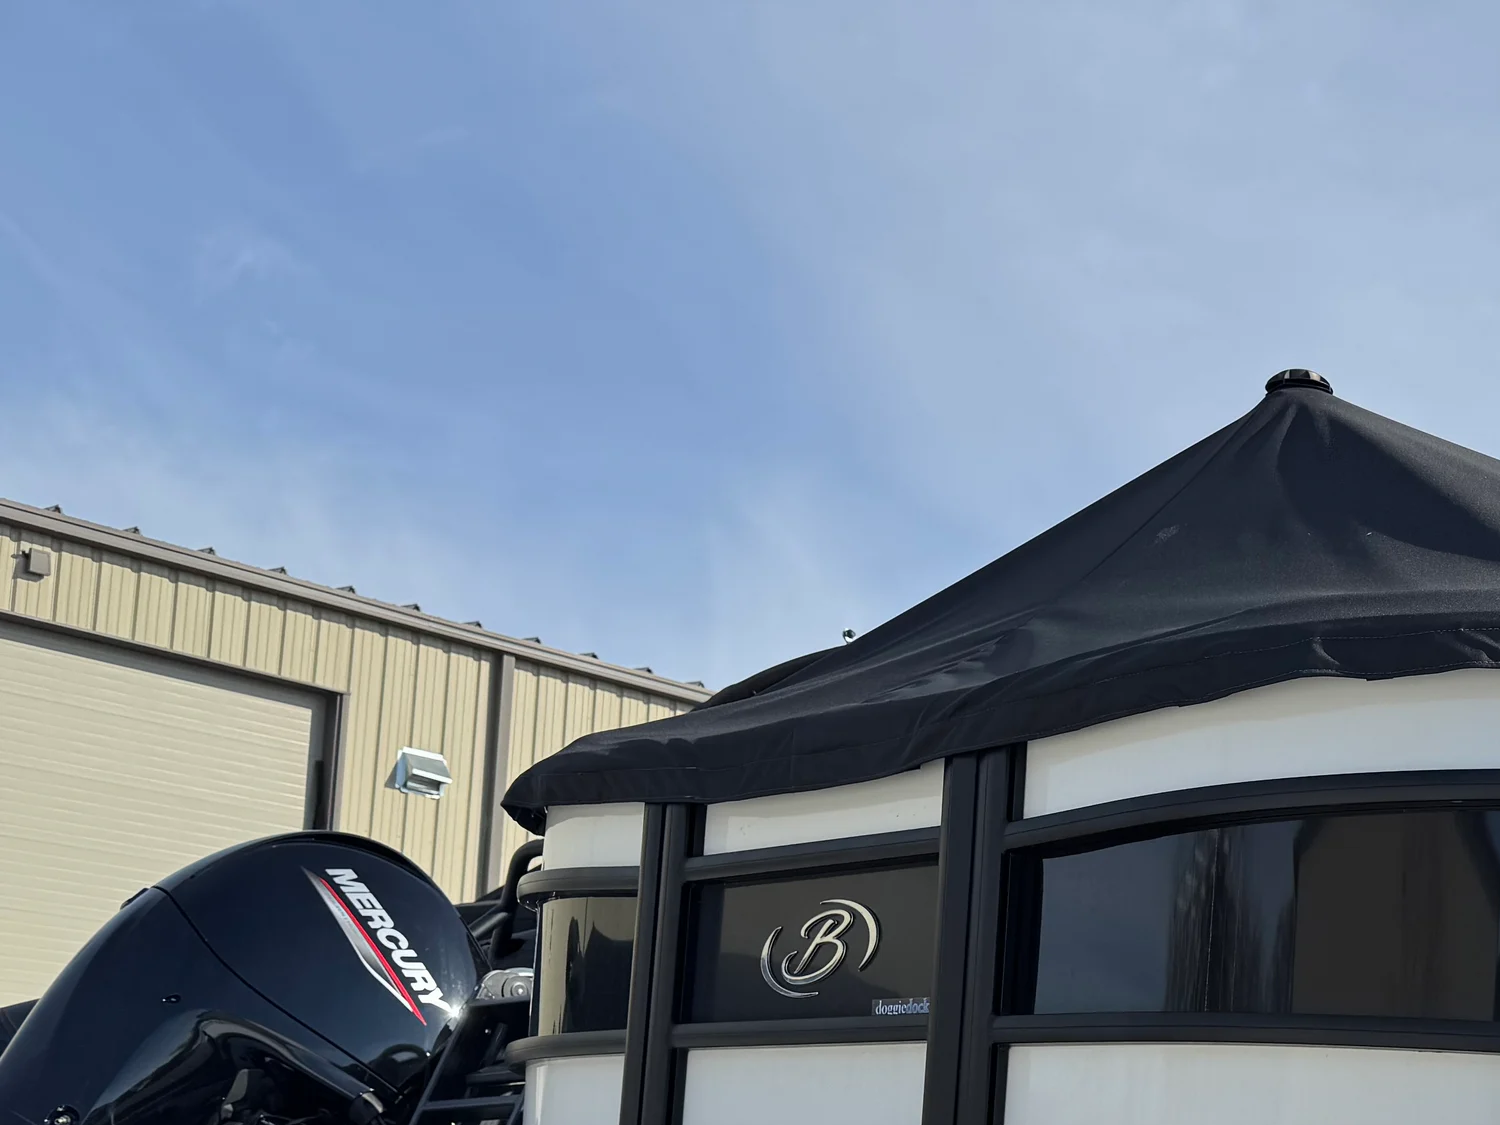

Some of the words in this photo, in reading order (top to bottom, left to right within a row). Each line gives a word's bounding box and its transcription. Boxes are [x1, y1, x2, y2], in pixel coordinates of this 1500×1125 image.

[325, 868, 457, 1016] MERCURY
[781, 909, 854, 985] B
[875, 997, 931, 1016] doggiedock
